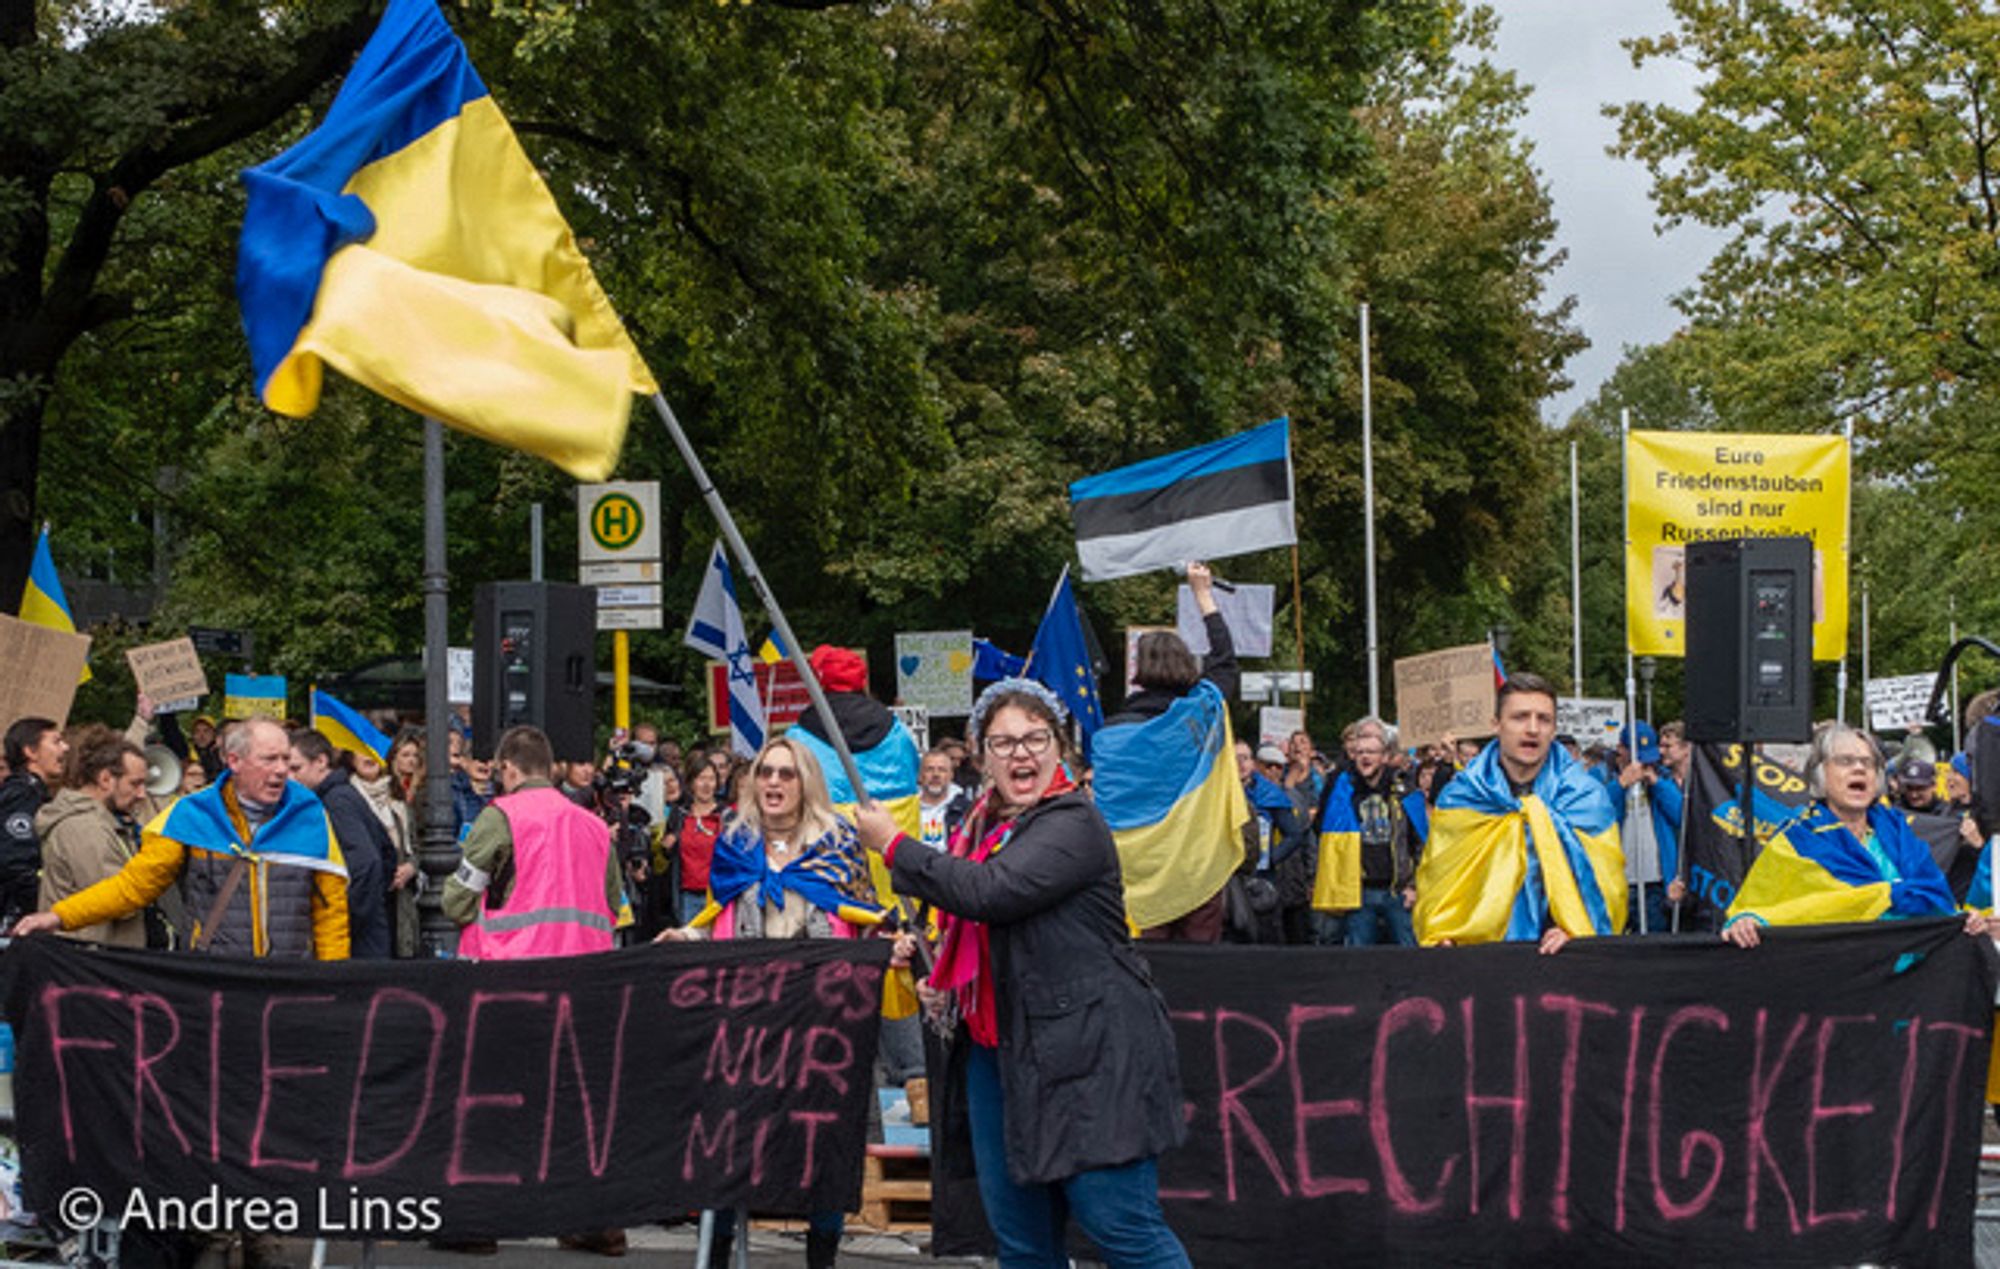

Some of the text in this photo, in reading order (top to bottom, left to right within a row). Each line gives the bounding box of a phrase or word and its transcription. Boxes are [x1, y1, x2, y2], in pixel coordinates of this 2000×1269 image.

[1715, 447, 1764, 464] Eure
[1656, 471, 1823, 492] Friedenstauben
[603, 506, 628, 536] H
[1697, 498, 1786, 517] sind nur
[1721, 743, 1806, 793] SOP
[669, 958, 803, 1007] GIBT
[703, 1018, 854, 1096] NUR
[40, 983, 632, 1187] FRIEDEN
[682, 1108, 839, 1189] MIT
